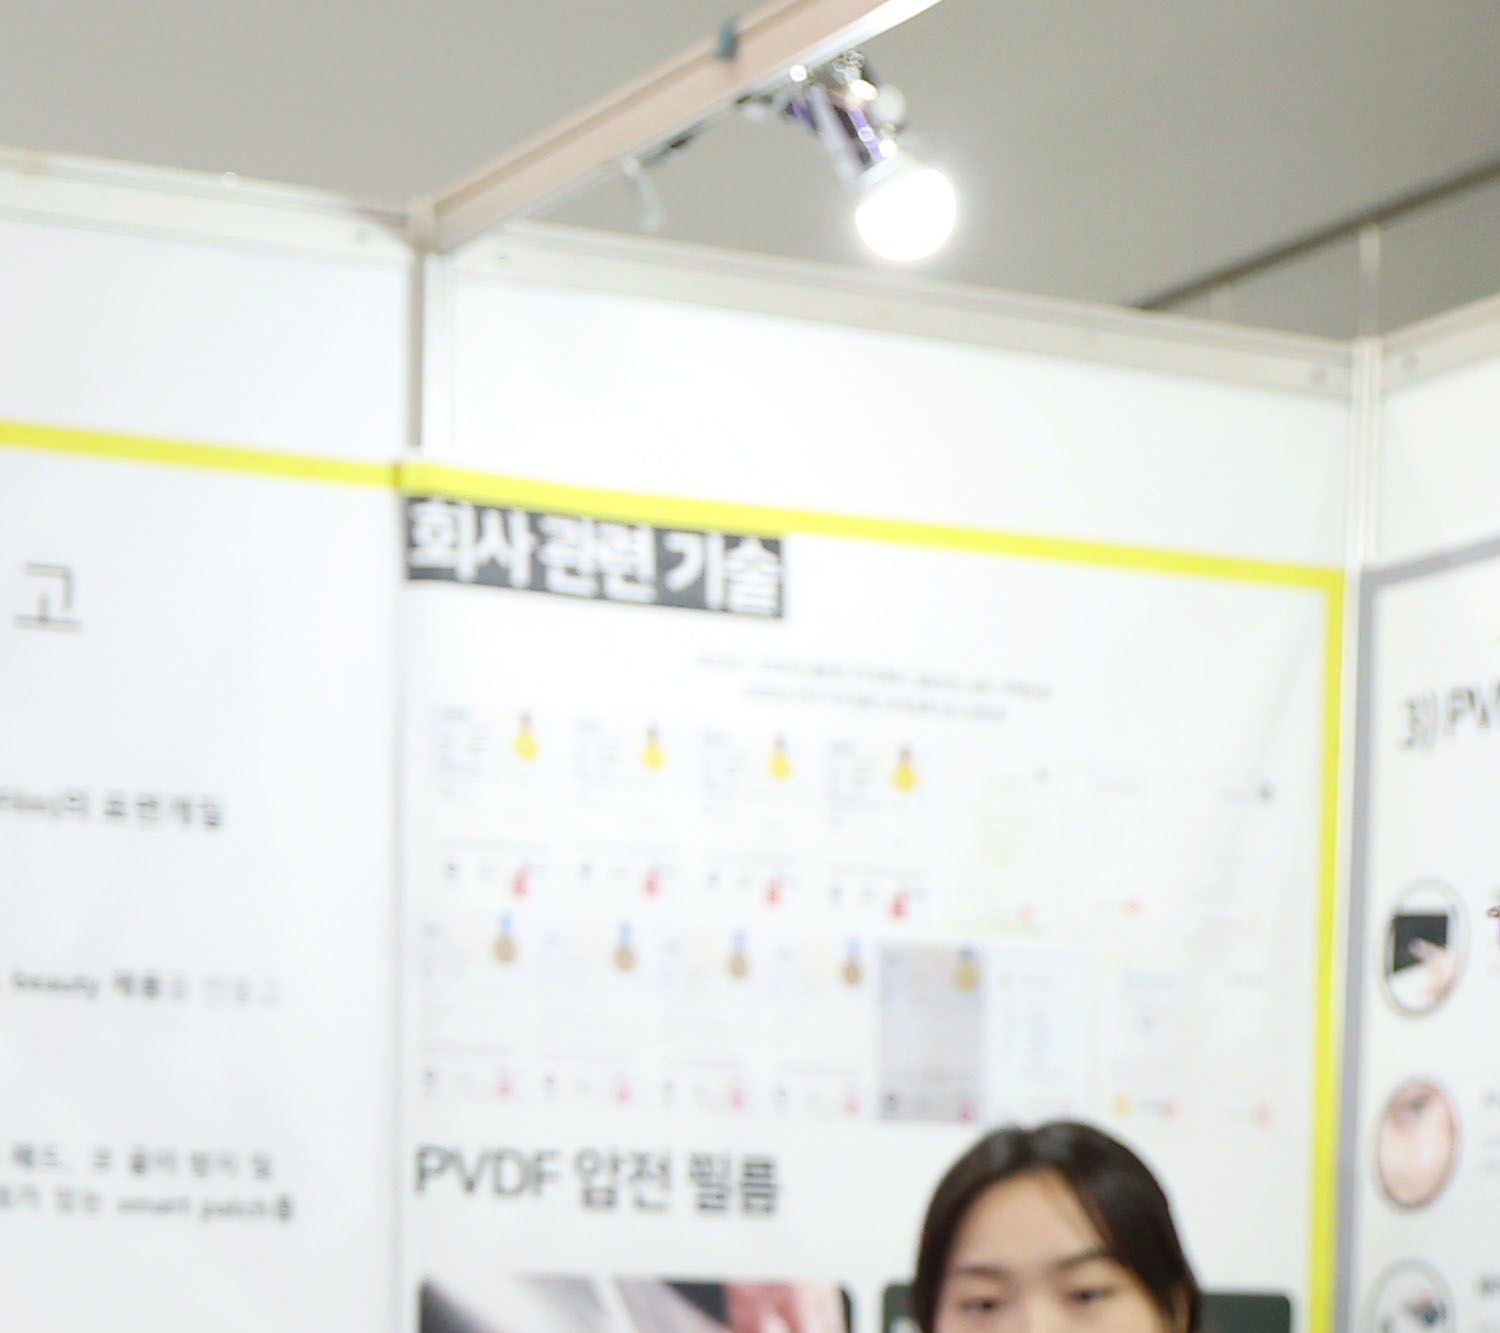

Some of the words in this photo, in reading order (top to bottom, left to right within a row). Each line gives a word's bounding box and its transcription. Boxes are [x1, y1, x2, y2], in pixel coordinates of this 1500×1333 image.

[409, 496, 536, 588] 회사
[538, 513, 658, 604] 관련
[664, 528, 783, 615] 기술
[414, 1144, 561, 1198] PVDF
[573, 1146, 672, 1214] 압전
[688, 1150, 778, 1218] 필름
